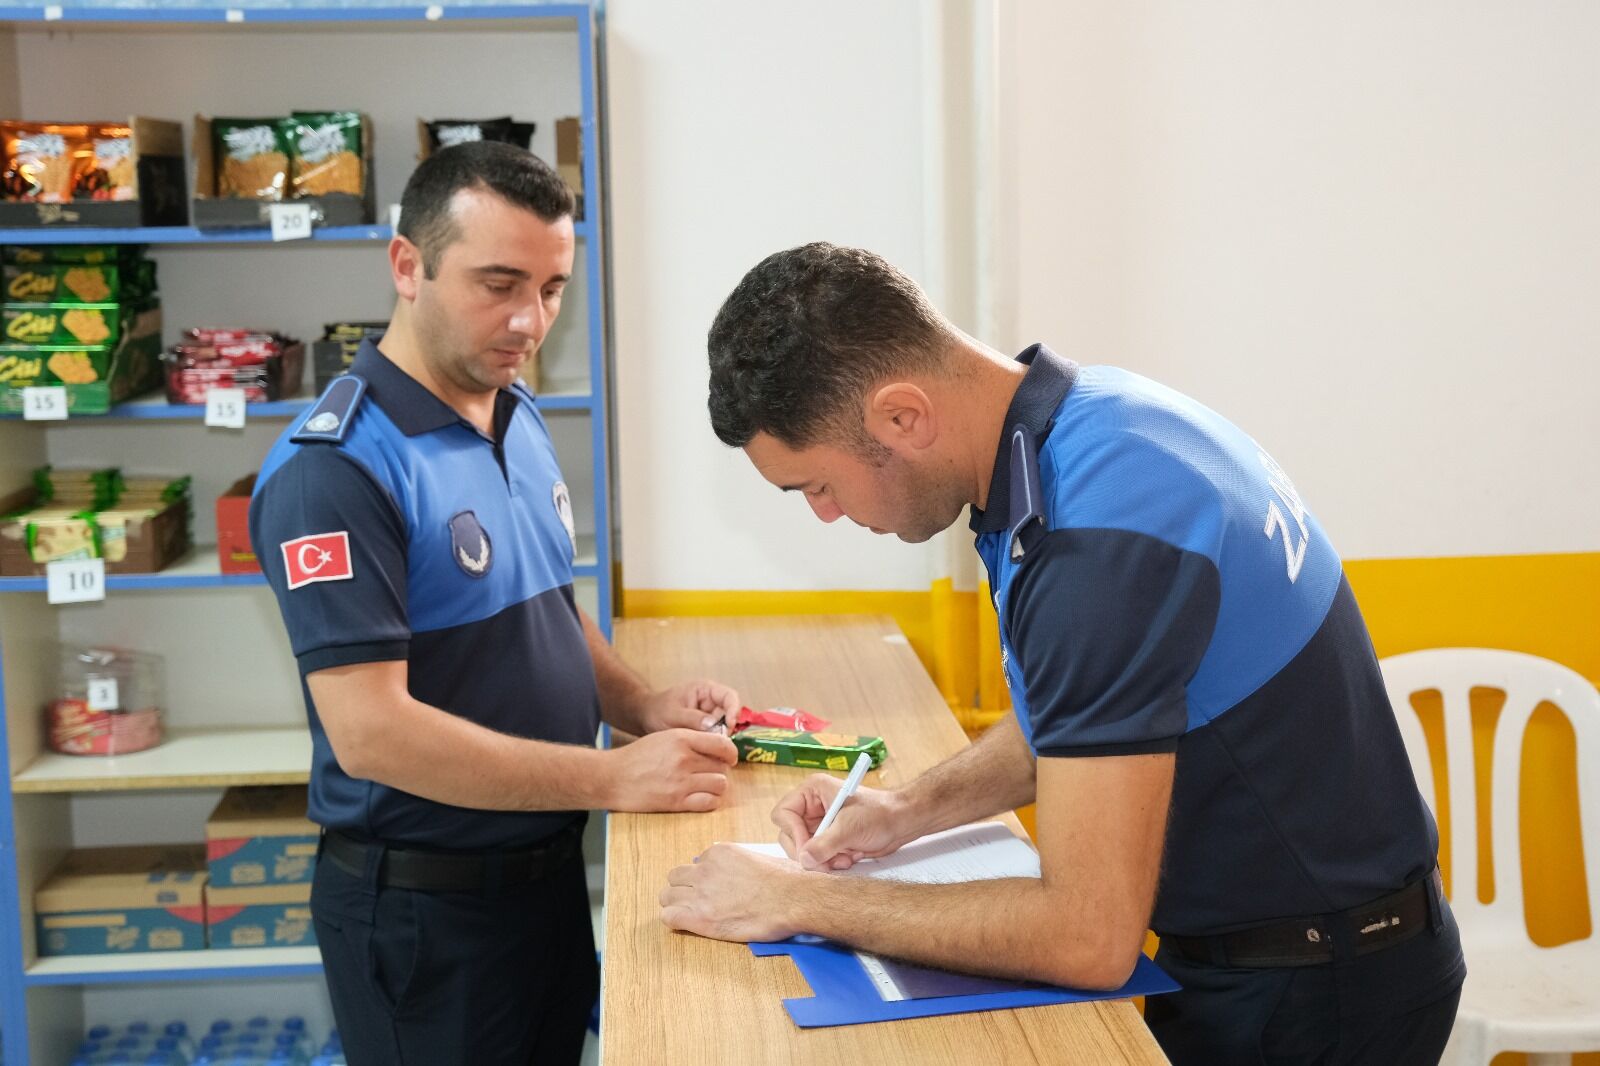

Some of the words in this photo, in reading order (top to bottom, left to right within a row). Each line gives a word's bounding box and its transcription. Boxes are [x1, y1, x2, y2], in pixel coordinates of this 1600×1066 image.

[281, 214, 303, 229] 20
[35, 395, 54, 410] 15
[216, 402, 236, 418] 15
[68, 571, 94, 592] 10
